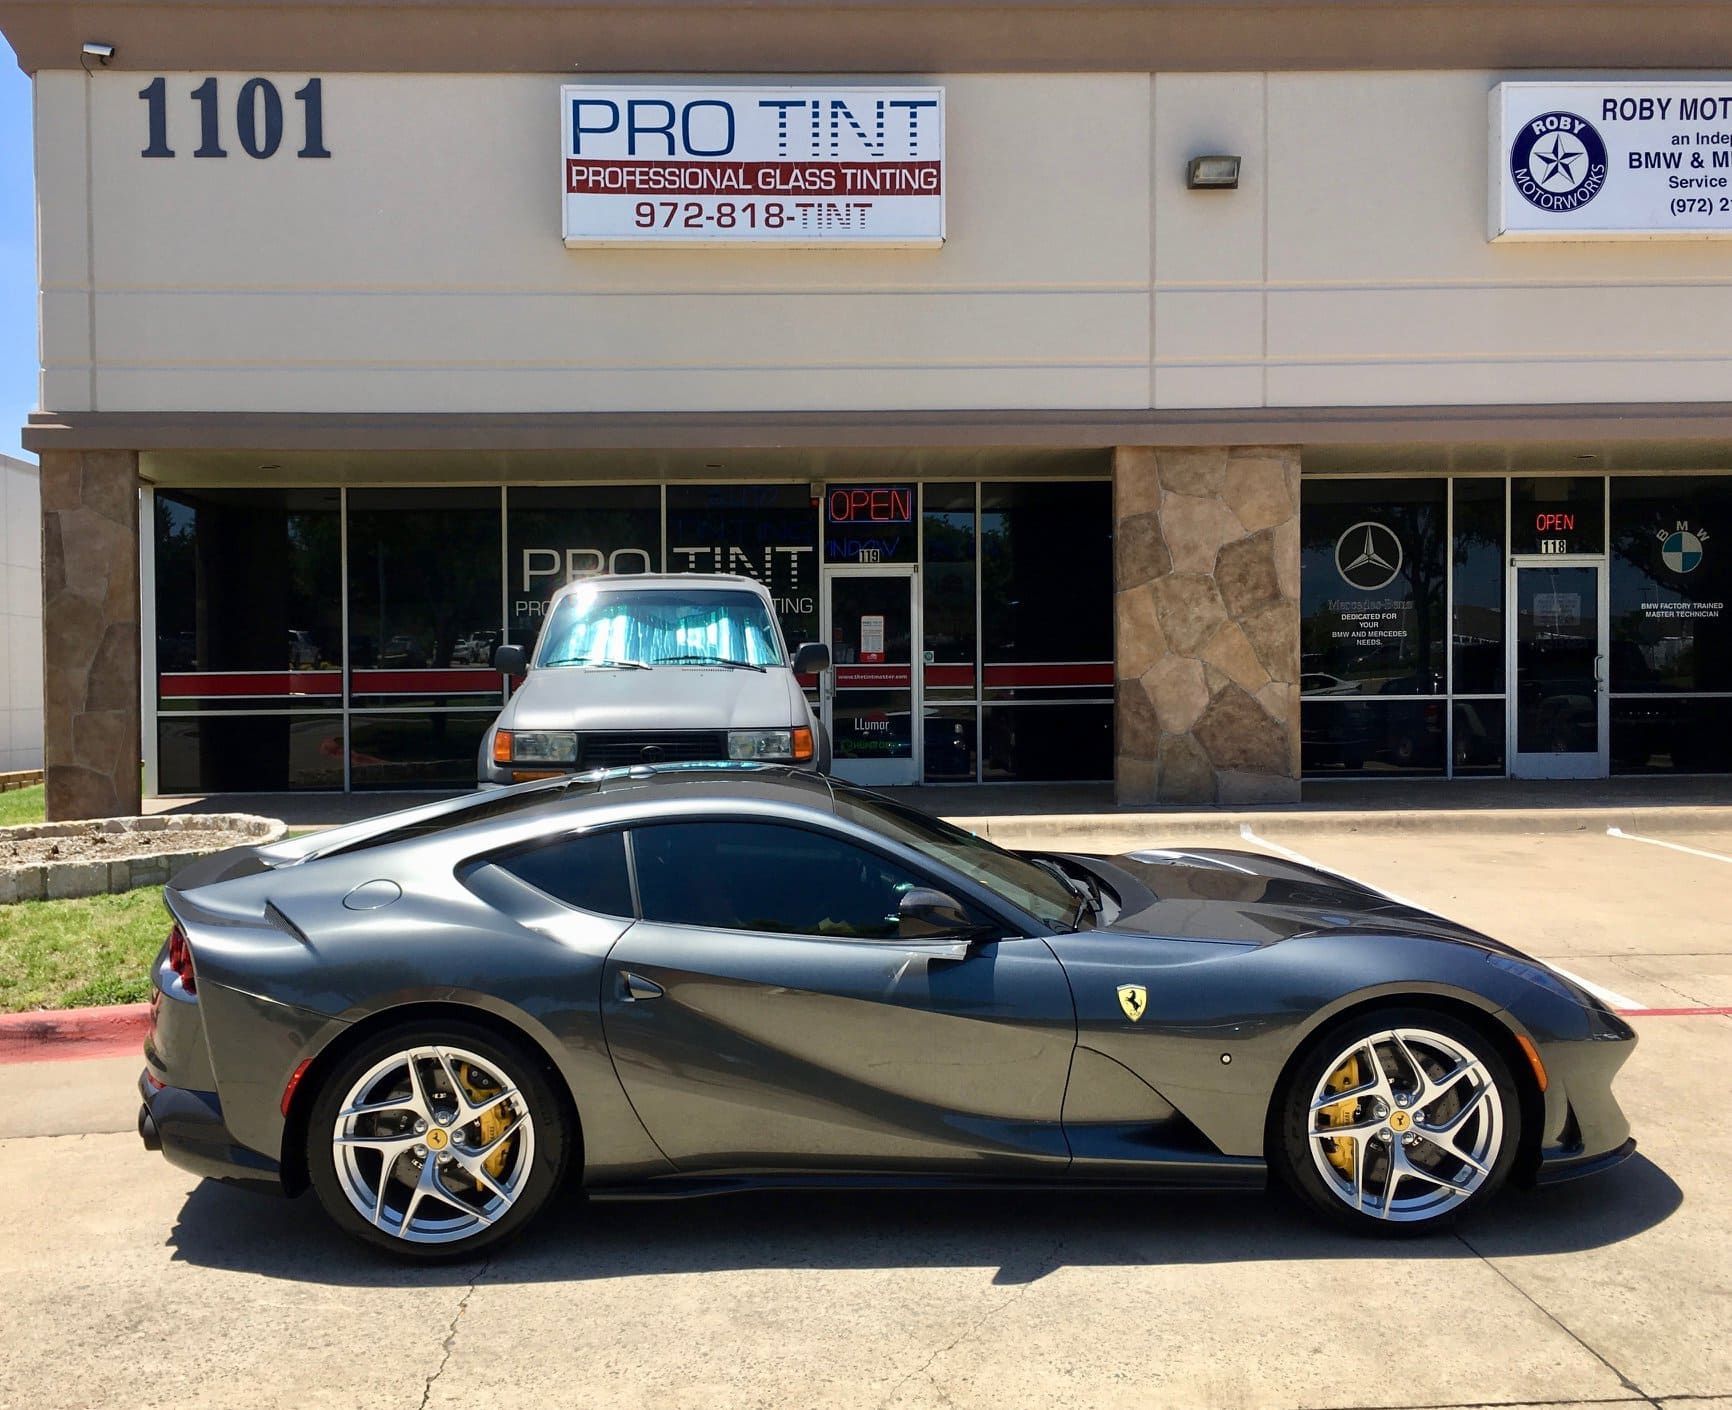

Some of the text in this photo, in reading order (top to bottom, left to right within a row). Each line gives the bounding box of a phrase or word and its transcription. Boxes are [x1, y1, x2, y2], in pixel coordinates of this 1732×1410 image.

[138, 76, 331, 159] 1101
[1602, 97, 1732, 121] ROBY MOT
[572, 99, 937, 157] PRO TINT
[1531, 116, 1587, 135] ROBY
[1671, 132, 1732, 147] an Inde
[1628, 151, 1683, 169] BMW
[1690, 152, 1705, 169] &
[571, 166, 938, 190] PROFESSIONAL GLASS TINTING
[1514, 164, 1605, 211] MOTORWORKS
[1668, 175, 1728, 189] Service
[635, 202, 873, 230] 972-818-TINT
[1670, 197, 1732, 217] (972) 2
[831, 490, 909, 521] OPEN
[1536, 513, 1574, 531] OPEN
[1656, 520, 1711, 542] BMW
[860, 549, 879, 562] 119
[1543, 540, 1566, 554] 118
[1367, 630, 1408, 638] MERCEDES
[854, 718, 890, 731] LLumar
